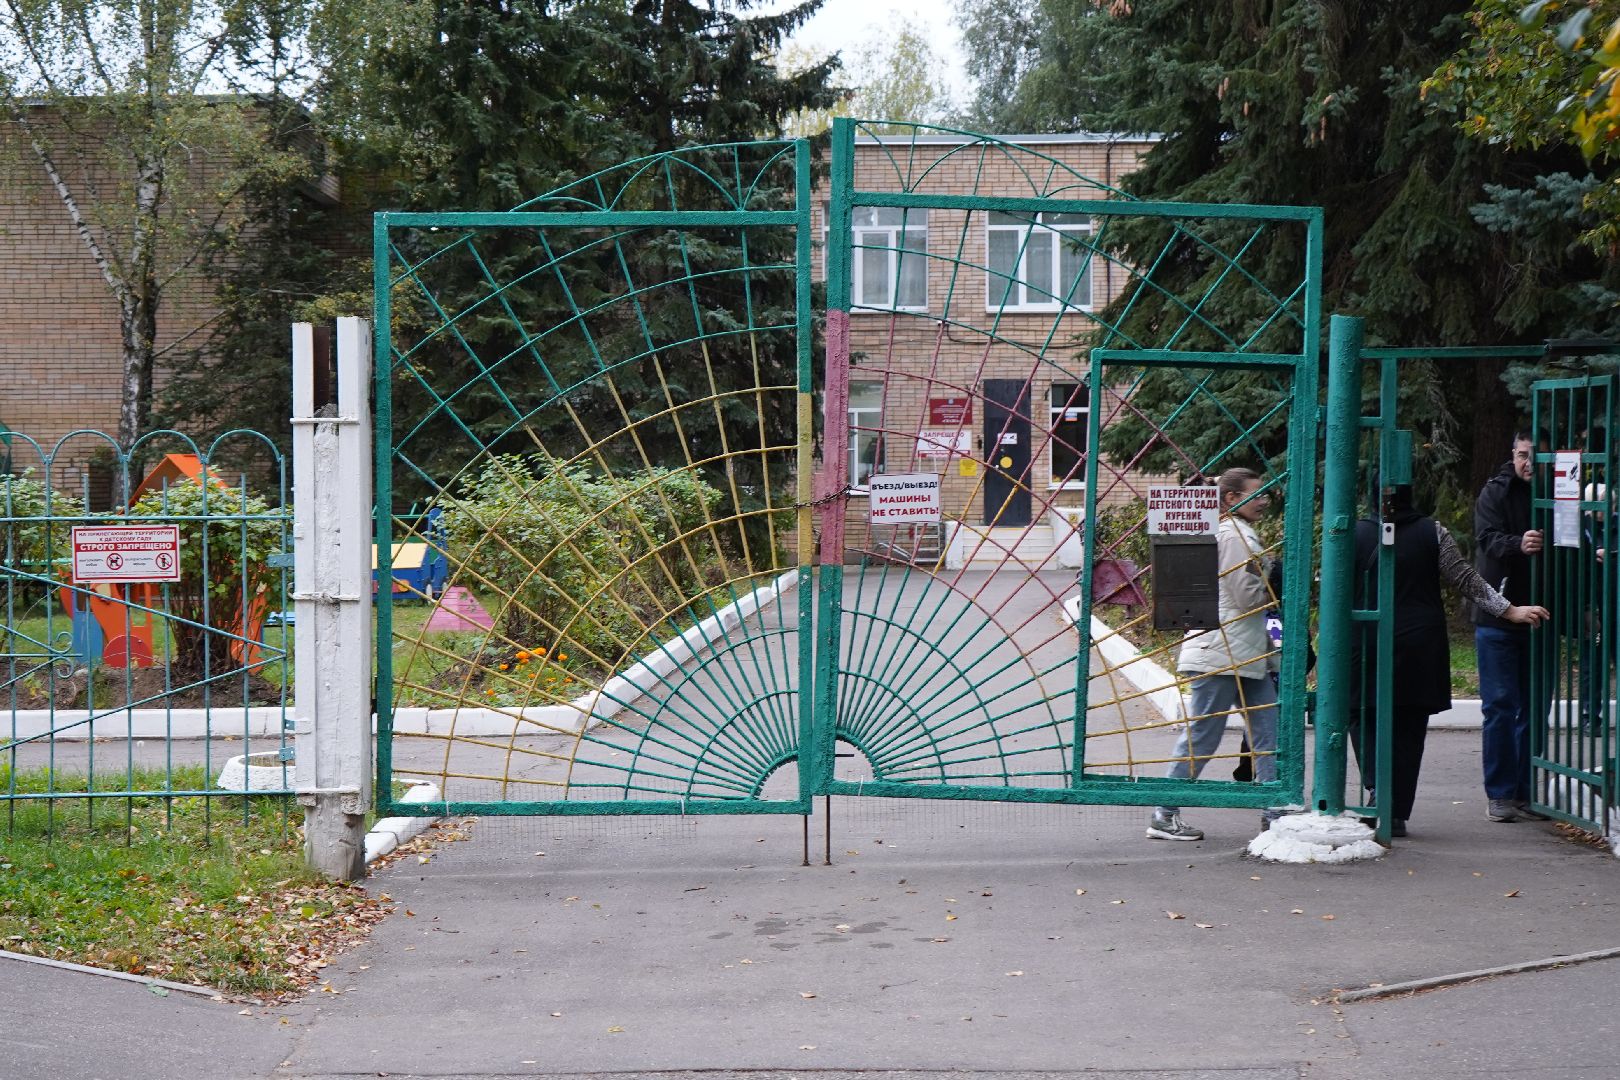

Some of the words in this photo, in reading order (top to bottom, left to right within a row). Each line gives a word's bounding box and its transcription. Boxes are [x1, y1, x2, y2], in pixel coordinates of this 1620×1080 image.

[872, 482, 938, 490] ВЪЕЗД/ВЫЕЗД!
[1150, 490, 1161, 498] НА
[1163, 489, 1217, 498] ТЕРРИТОРИИ
[880, 495, 931, 503] МАШИНЫ
[1149, 500, 1192, 510] ДЕТСКОГО
[1195, 500, 1218, 510] САДА
[888, 507, 939, 516] СТАВИТЬ!
[1165, 511, 1202, 520] КУРЕНИЕ
[1158, 522, 1210, 532] ЗАПРЕЩЕНО
[80, 543, 115, 551] СТРОГО
[117, 542, 172, 551] ЗАПРЕЩЕНО
